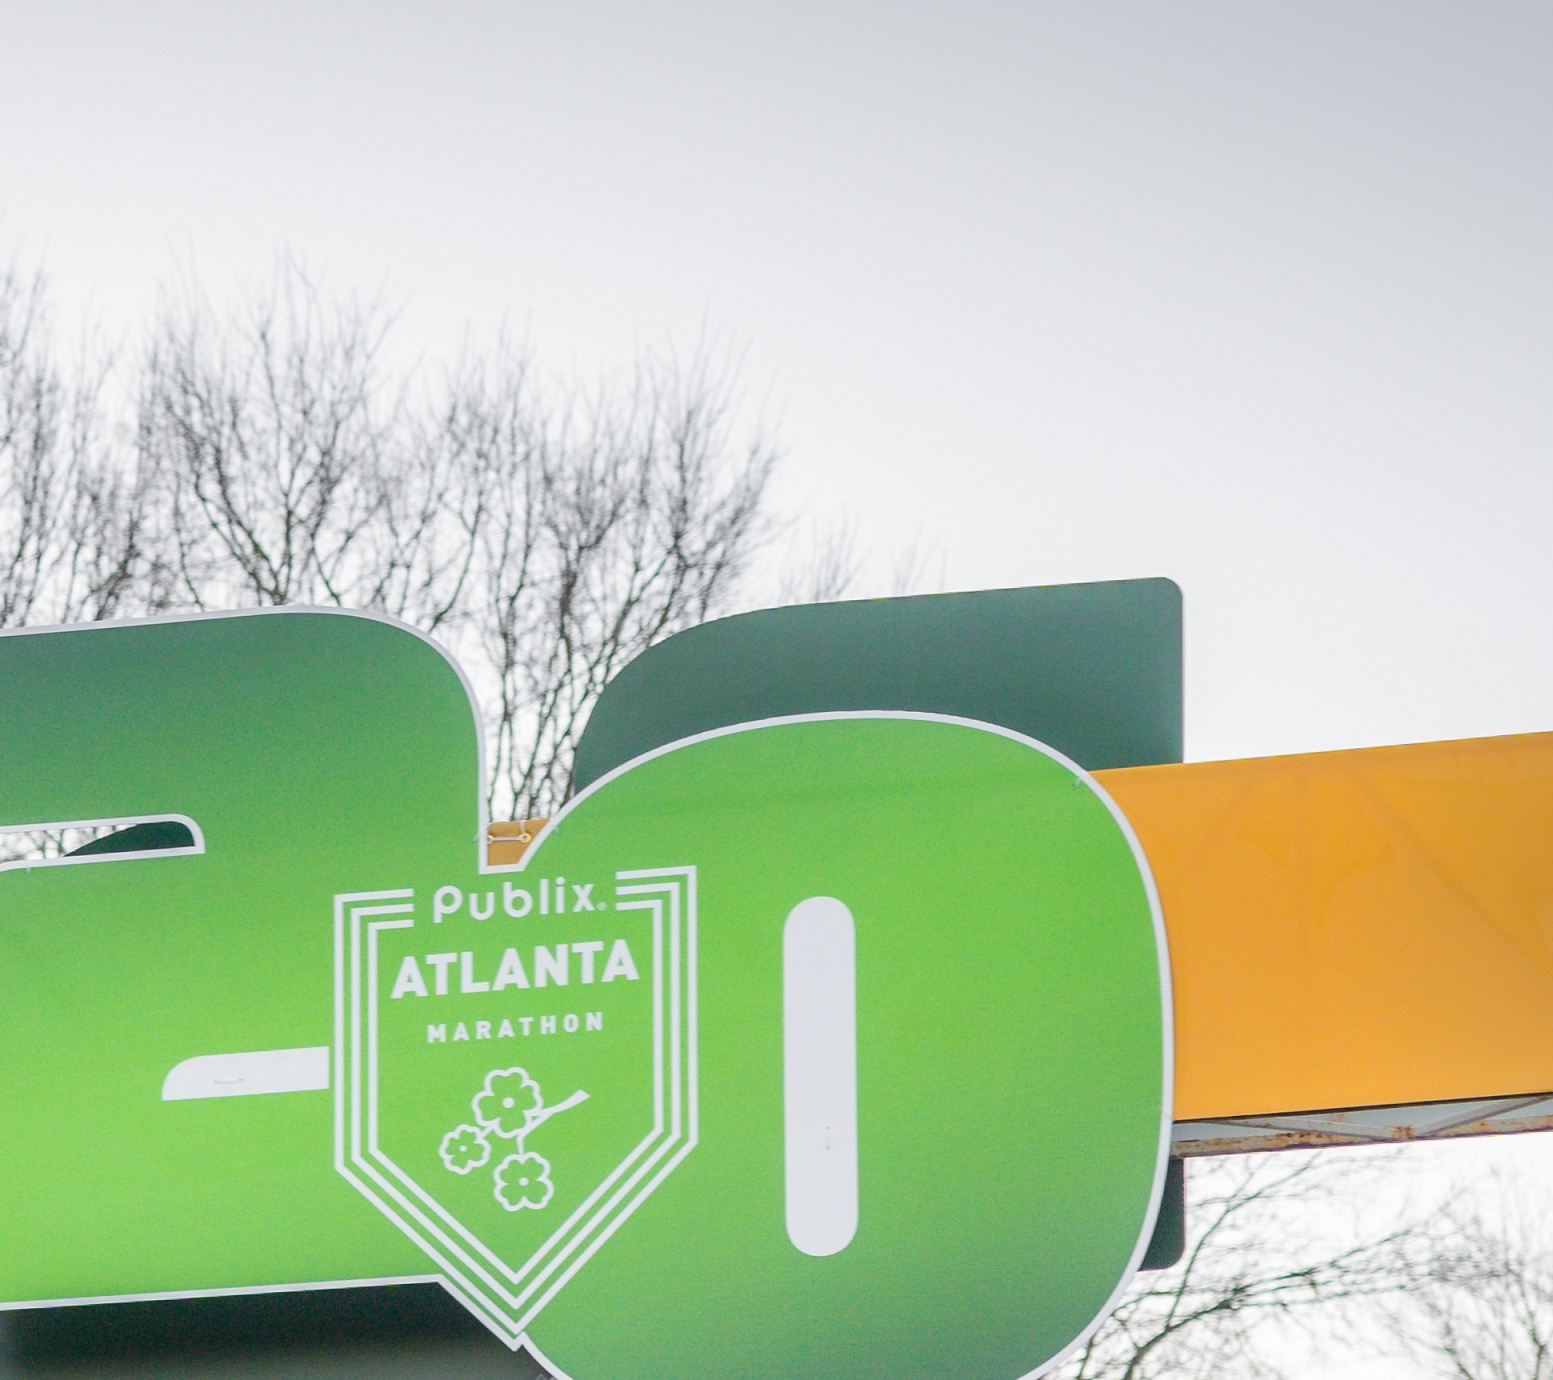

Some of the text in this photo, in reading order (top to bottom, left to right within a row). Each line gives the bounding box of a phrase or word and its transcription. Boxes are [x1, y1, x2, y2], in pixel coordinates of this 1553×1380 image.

[433, 876, 606, 923] Publix
[390, 939, 639, 999] ATLANTA
[427, 1011, 602, 1043] MARATHON
